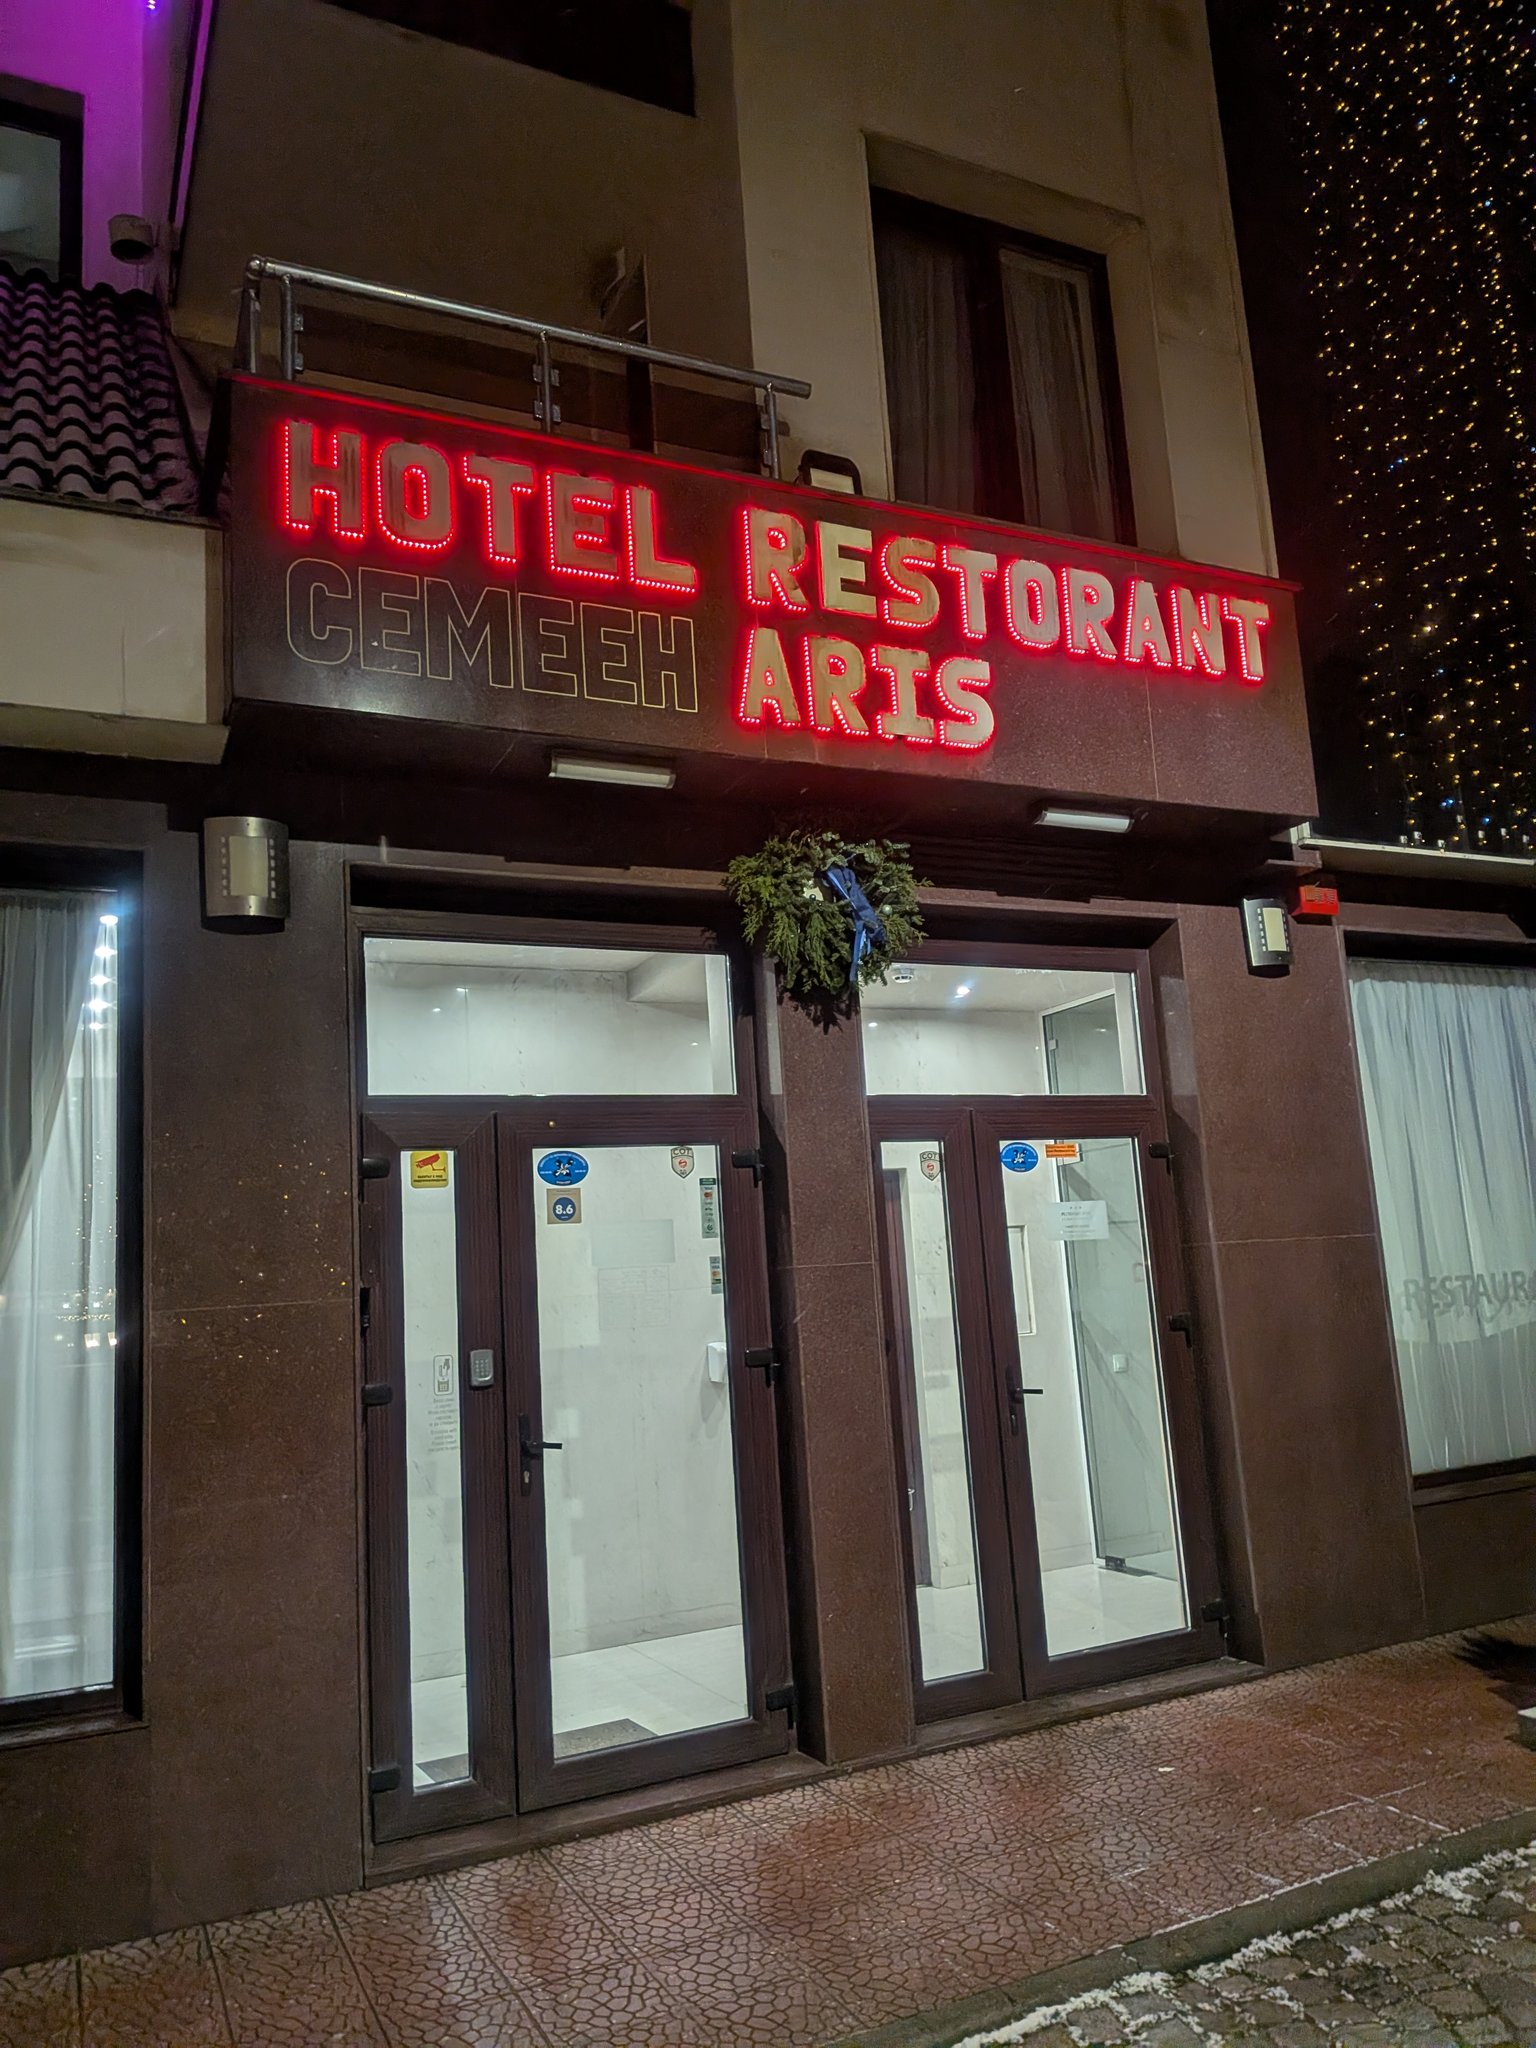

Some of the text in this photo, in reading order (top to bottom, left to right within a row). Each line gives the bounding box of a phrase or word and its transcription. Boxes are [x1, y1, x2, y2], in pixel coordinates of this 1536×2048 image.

[284, 420, 698, 594] HOTEL
[286, 557, 699, 714] СЕМЕЕН
[742, 506, 1269, 683] RESTORANT
[738, 627, 995, 750] ARIS
[555, 1204, 574, 1215] 8.6
